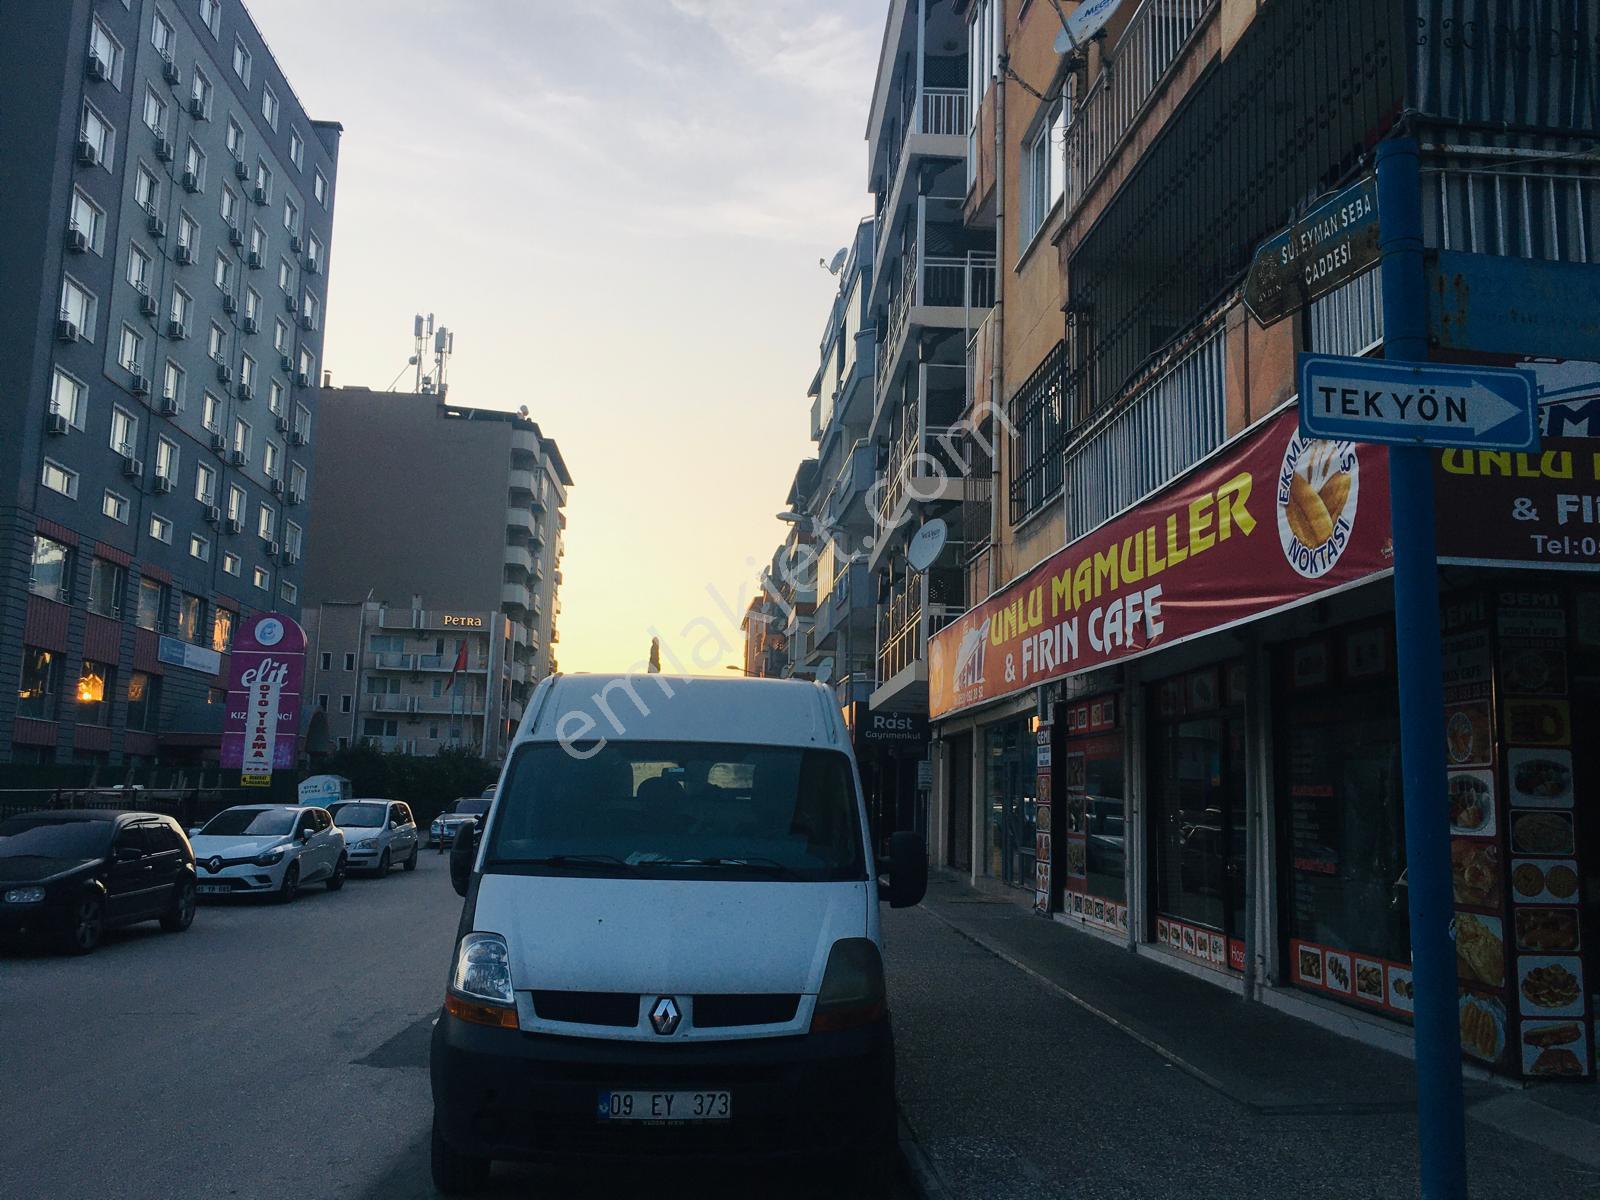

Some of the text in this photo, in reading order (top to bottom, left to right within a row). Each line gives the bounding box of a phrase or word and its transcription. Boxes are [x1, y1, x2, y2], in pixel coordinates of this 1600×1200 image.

[1341, 194, 1371, 228] SEBA
[1305, 235, 1351, 285] CADDESİ
[1512, 497, 1540, 521] &
[991, 471, 1258, 647] UNLU MAMULLER
[1288, 517, 1351, 574] NOKTASI
[1530, 535, 1600, 556] Tel:0
[1004, 583, 1165, 684] & FIRIN CAFE
[257, 684, 271, 707] OTO
[873, 715, 913, 730] Rast
[610, 1093, 729, 1116] 09 EY 373
